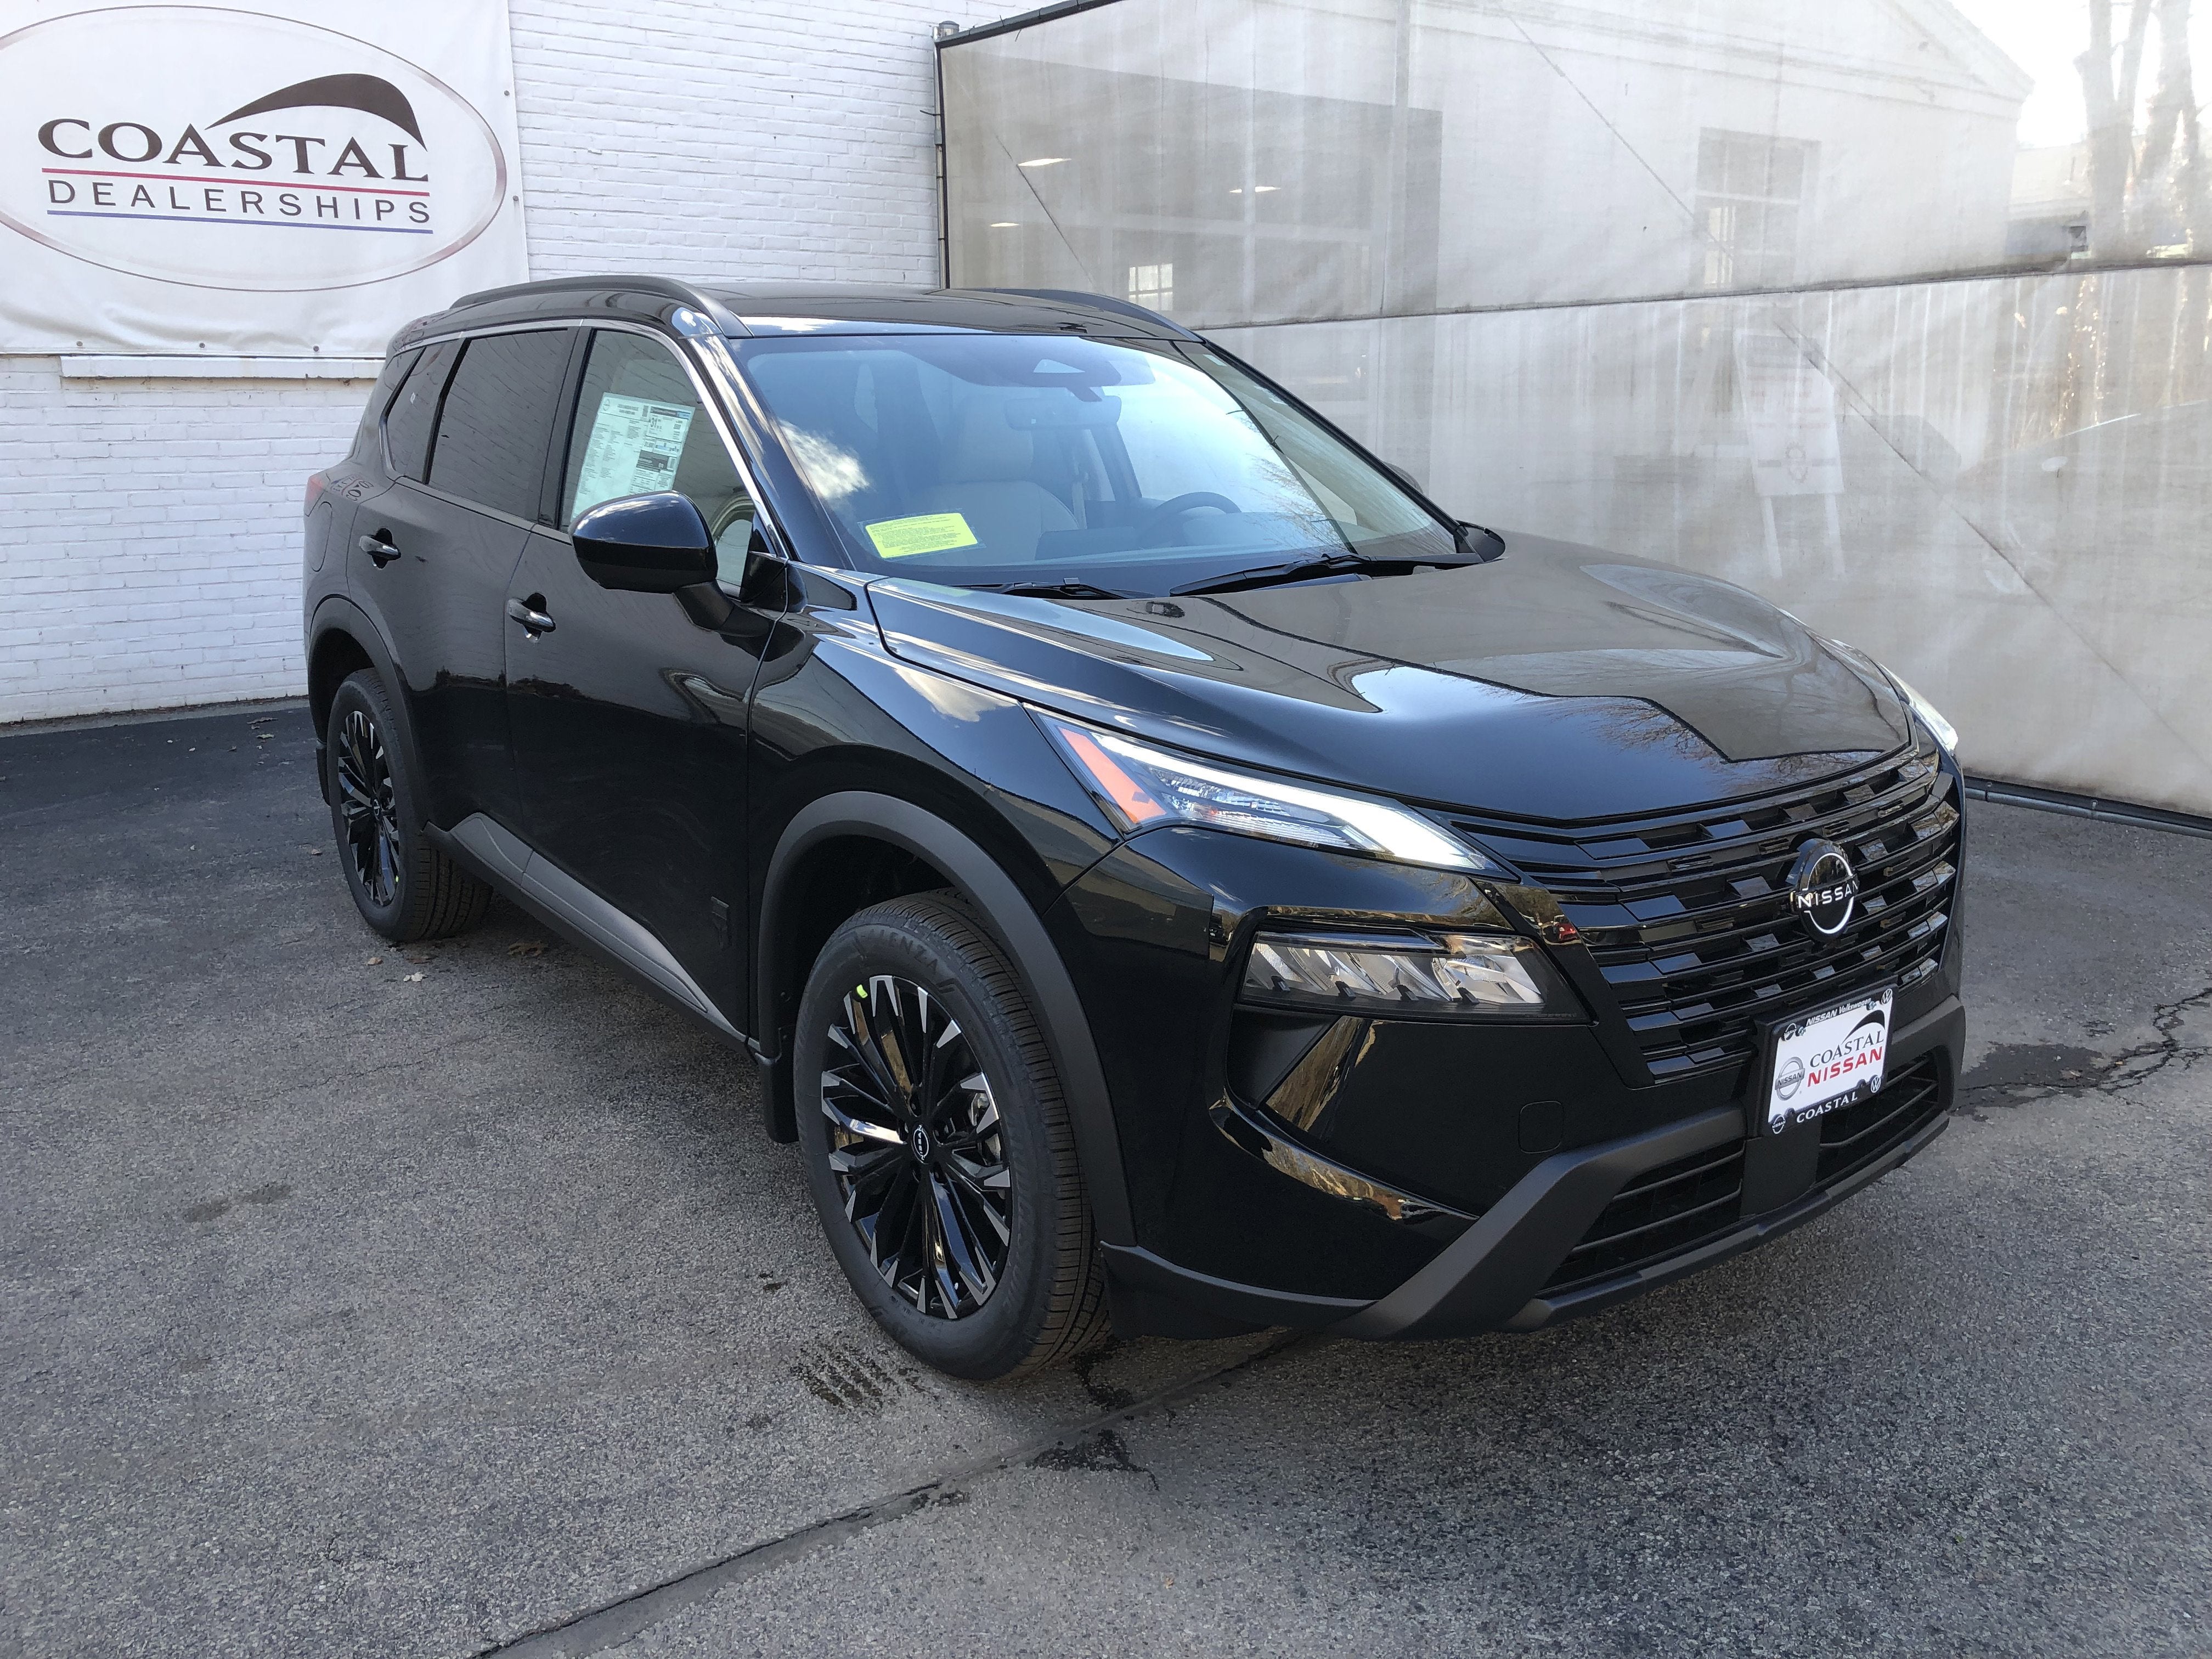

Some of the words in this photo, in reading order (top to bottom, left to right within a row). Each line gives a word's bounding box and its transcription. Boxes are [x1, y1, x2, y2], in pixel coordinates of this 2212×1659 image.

[38, 119, 429, 182] COASTAL
[48, 179, 431, 223] DEALERSHIPS
[1797, 879, 1858, 909] NISSAN
[1806, 1008, 1838, 1026] NISSAN
[1839, 997, 1872, 1014] Volkswagen
[1807, 1046, 1883, 1087] NISSAN
[1810, 1030, 1884, 1068] COASTAL
[1777, 1071, 1802, 1087] NISSAN
[1796, 1091, 1858, 1123] COASTAL
